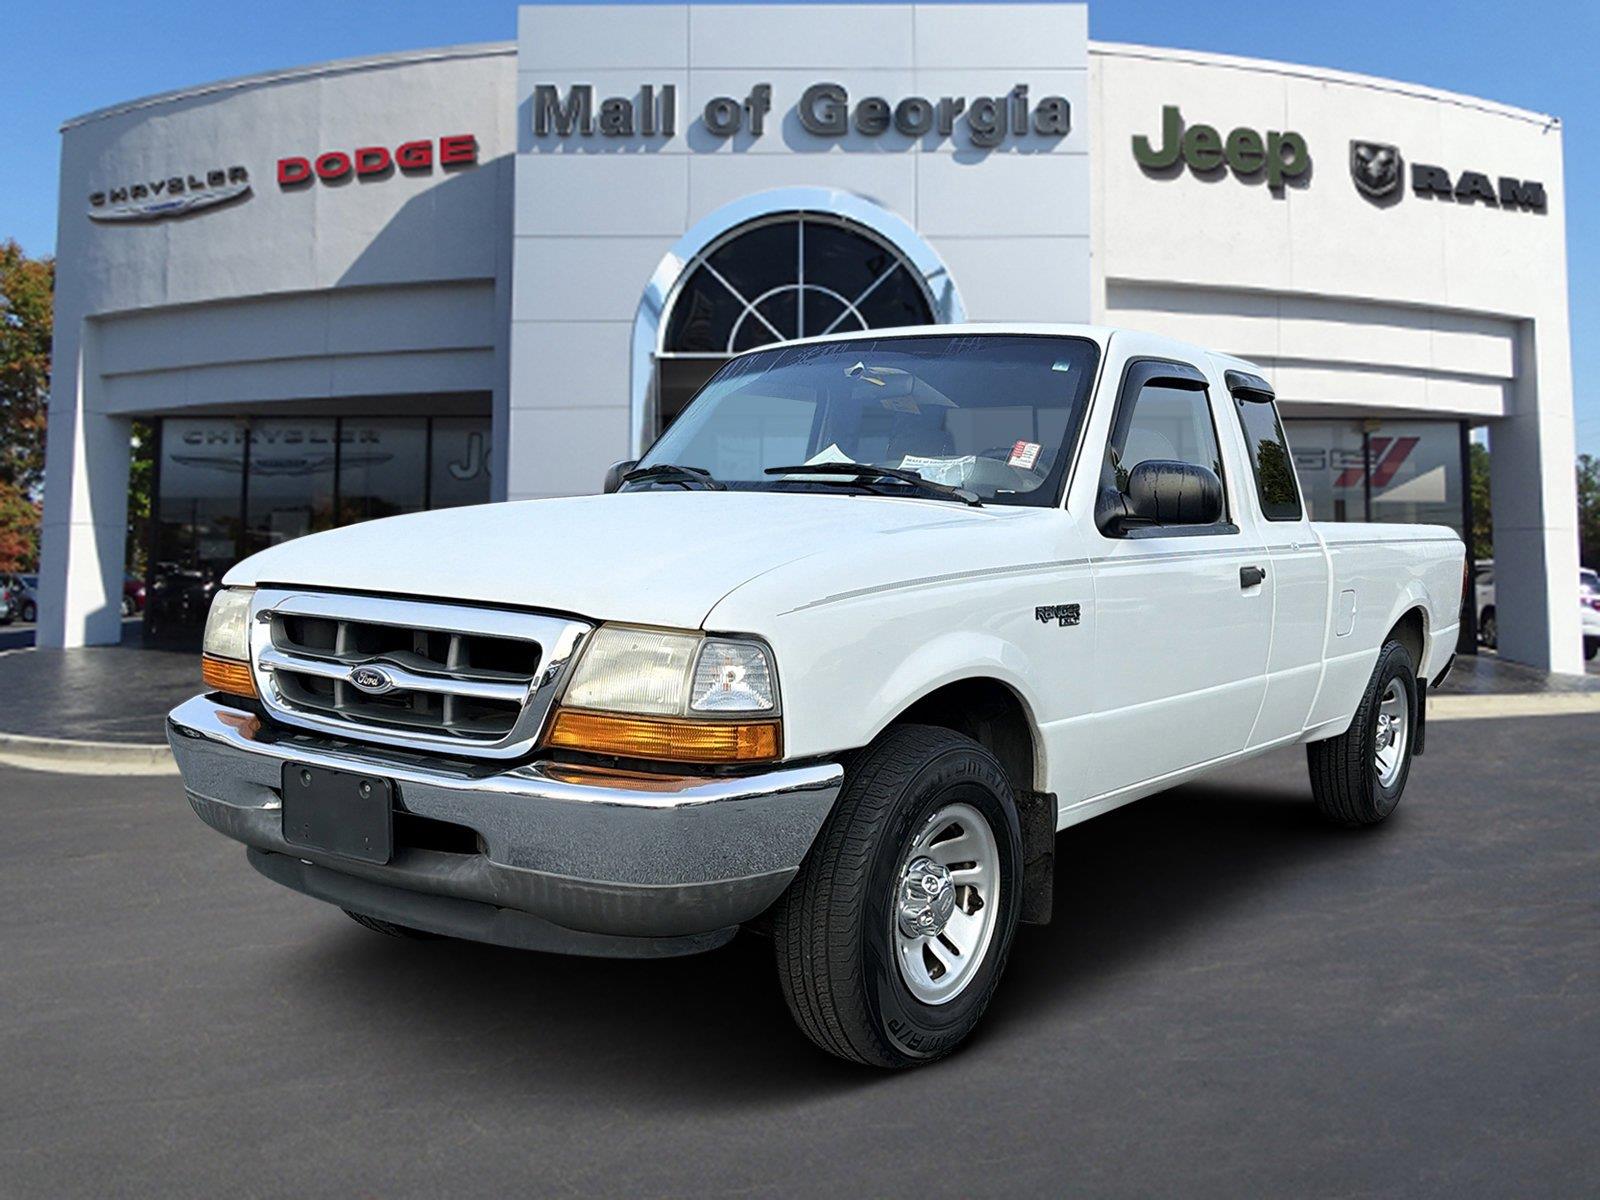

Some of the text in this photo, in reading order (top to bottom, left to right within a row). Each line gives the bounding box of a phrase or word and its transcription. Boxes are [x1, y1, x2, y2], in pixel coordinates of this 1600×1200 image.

[533, 82, 1072, 148] Mall of Georgia
[277, 133, 478, 187] DODGE
[1132, 105, 1308, 195] Jeep
[89, 166, 249, 206] CHRYSLER
[1411, 162, 1548, 214] RAM
[358, 670, 378, 686] Ford
